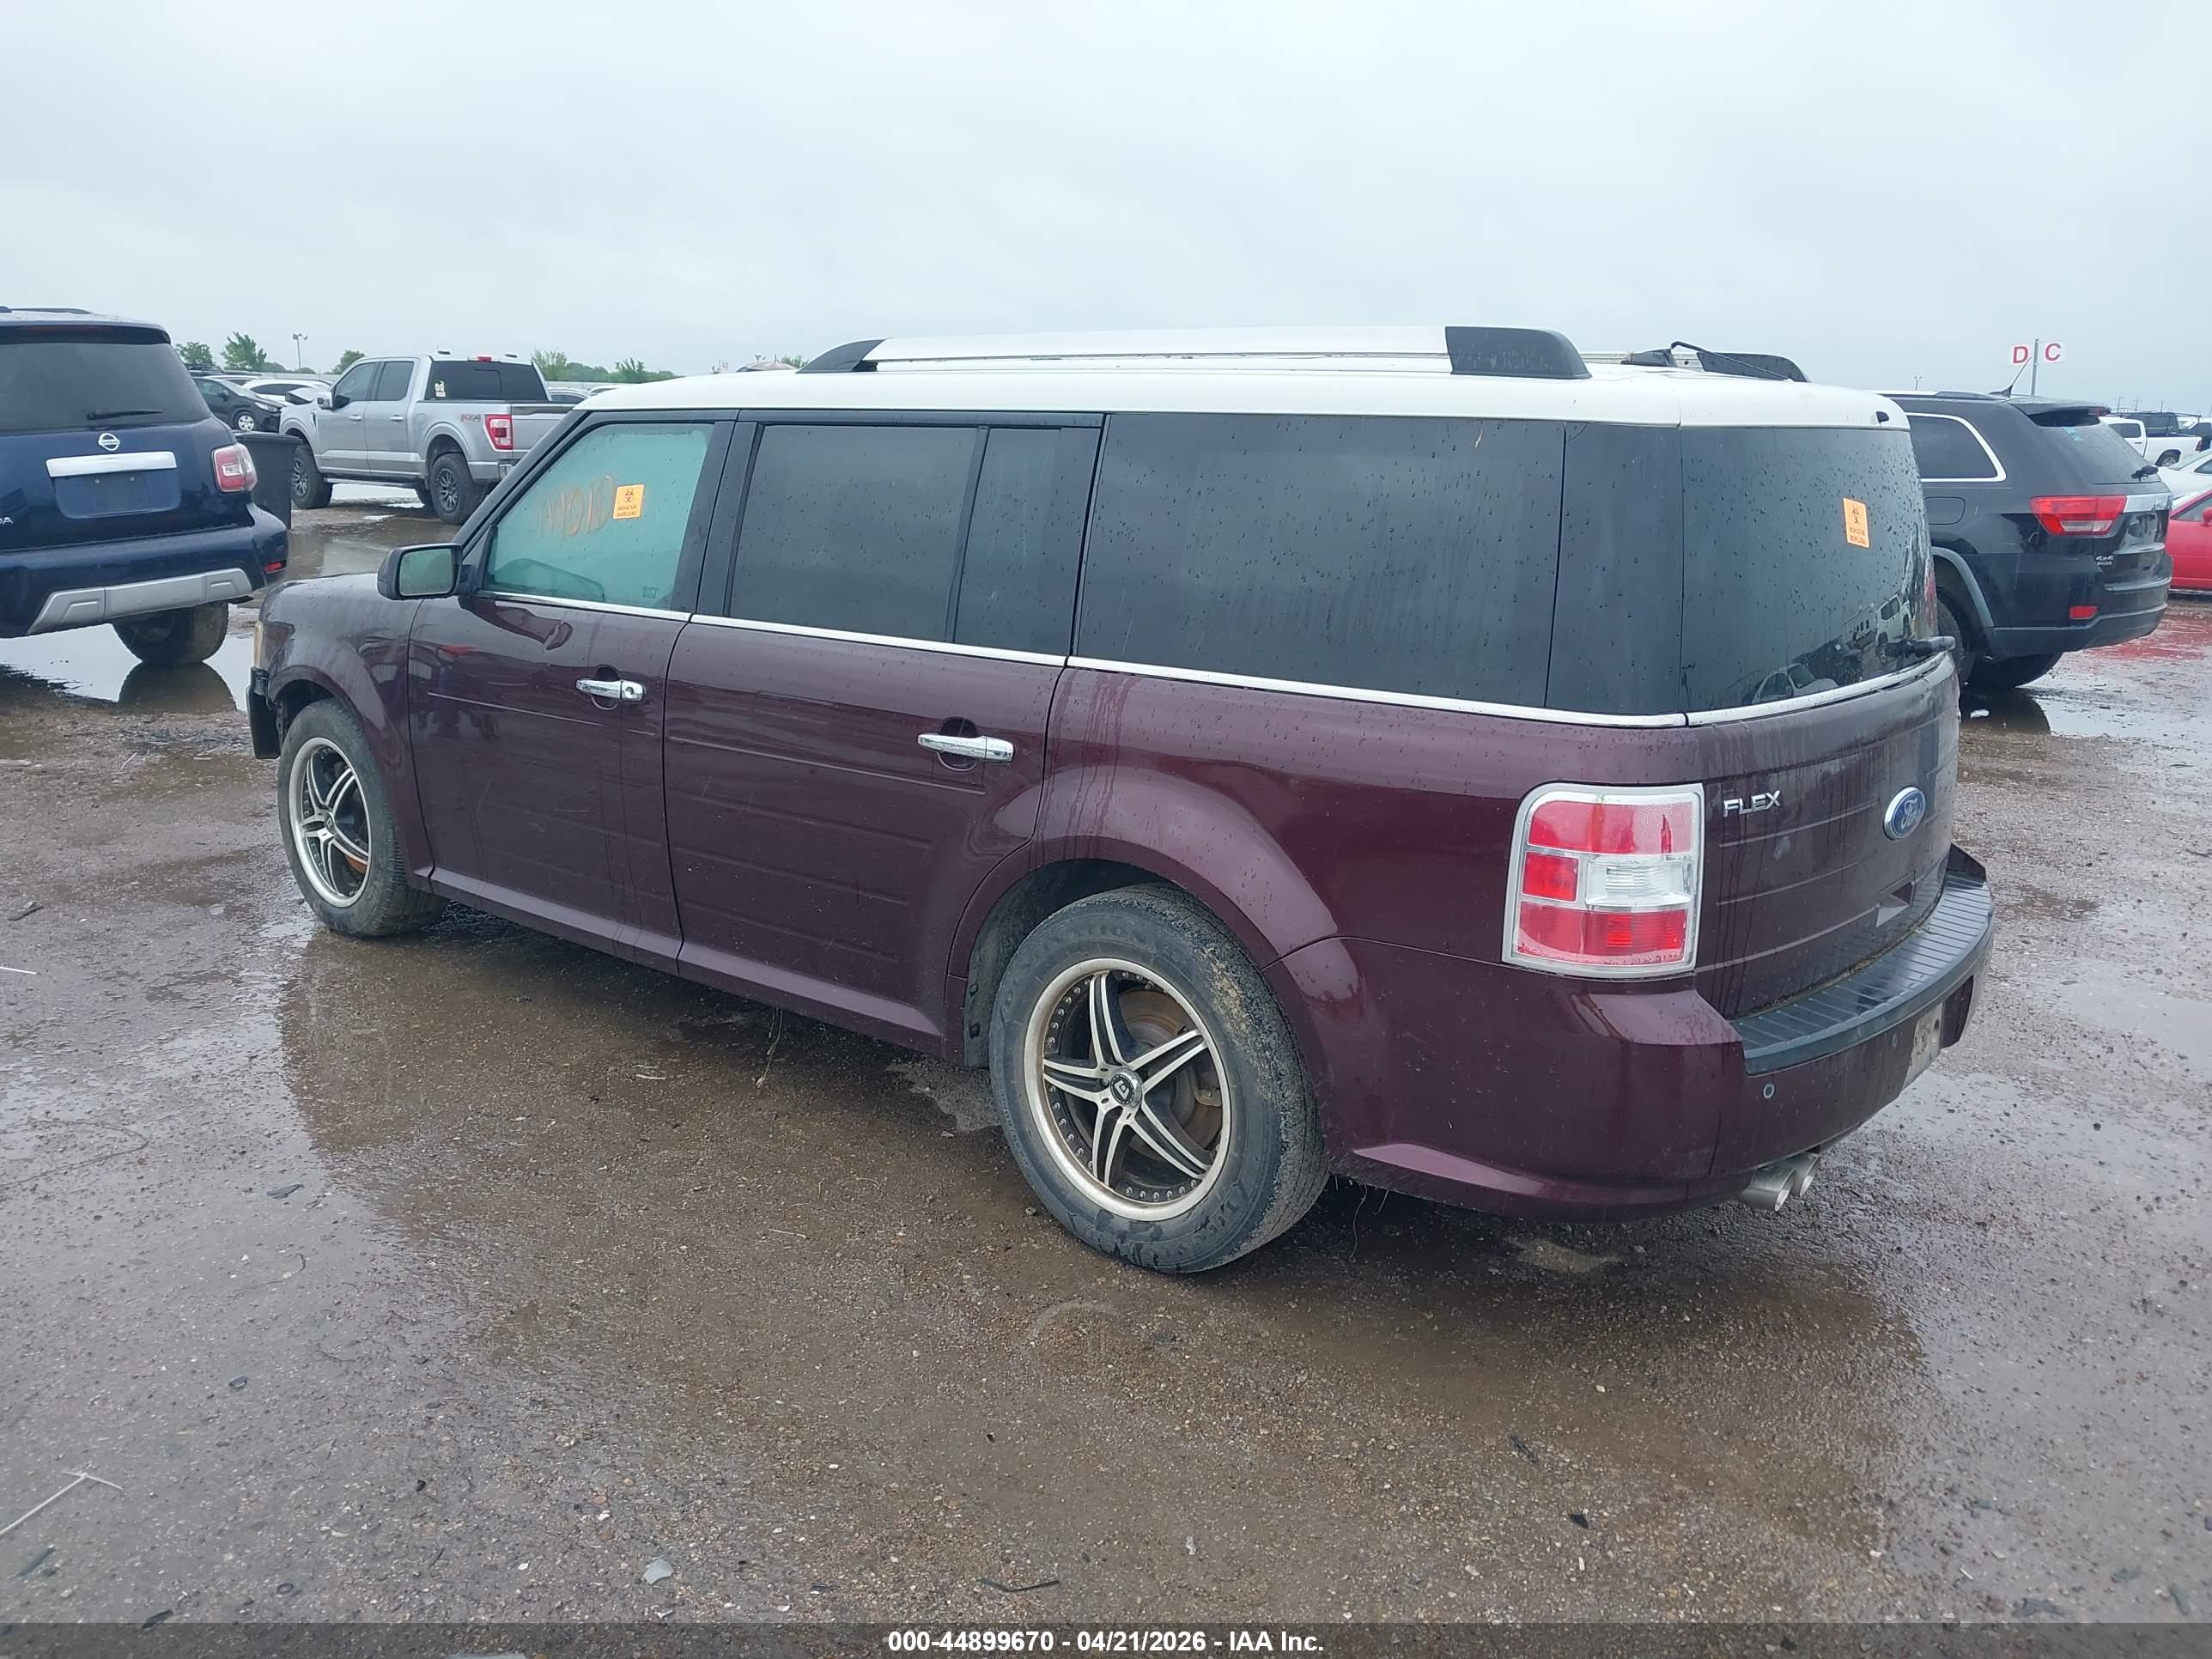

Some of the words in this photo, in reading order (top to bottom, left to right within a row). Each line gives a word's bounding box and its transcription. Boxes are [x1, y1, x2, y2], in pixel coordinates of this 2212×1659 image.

[2013, 345, 2029, 364] D
[2045, 343, 2062, 362] C
[1723, 789, 1782, 817] FLEX
